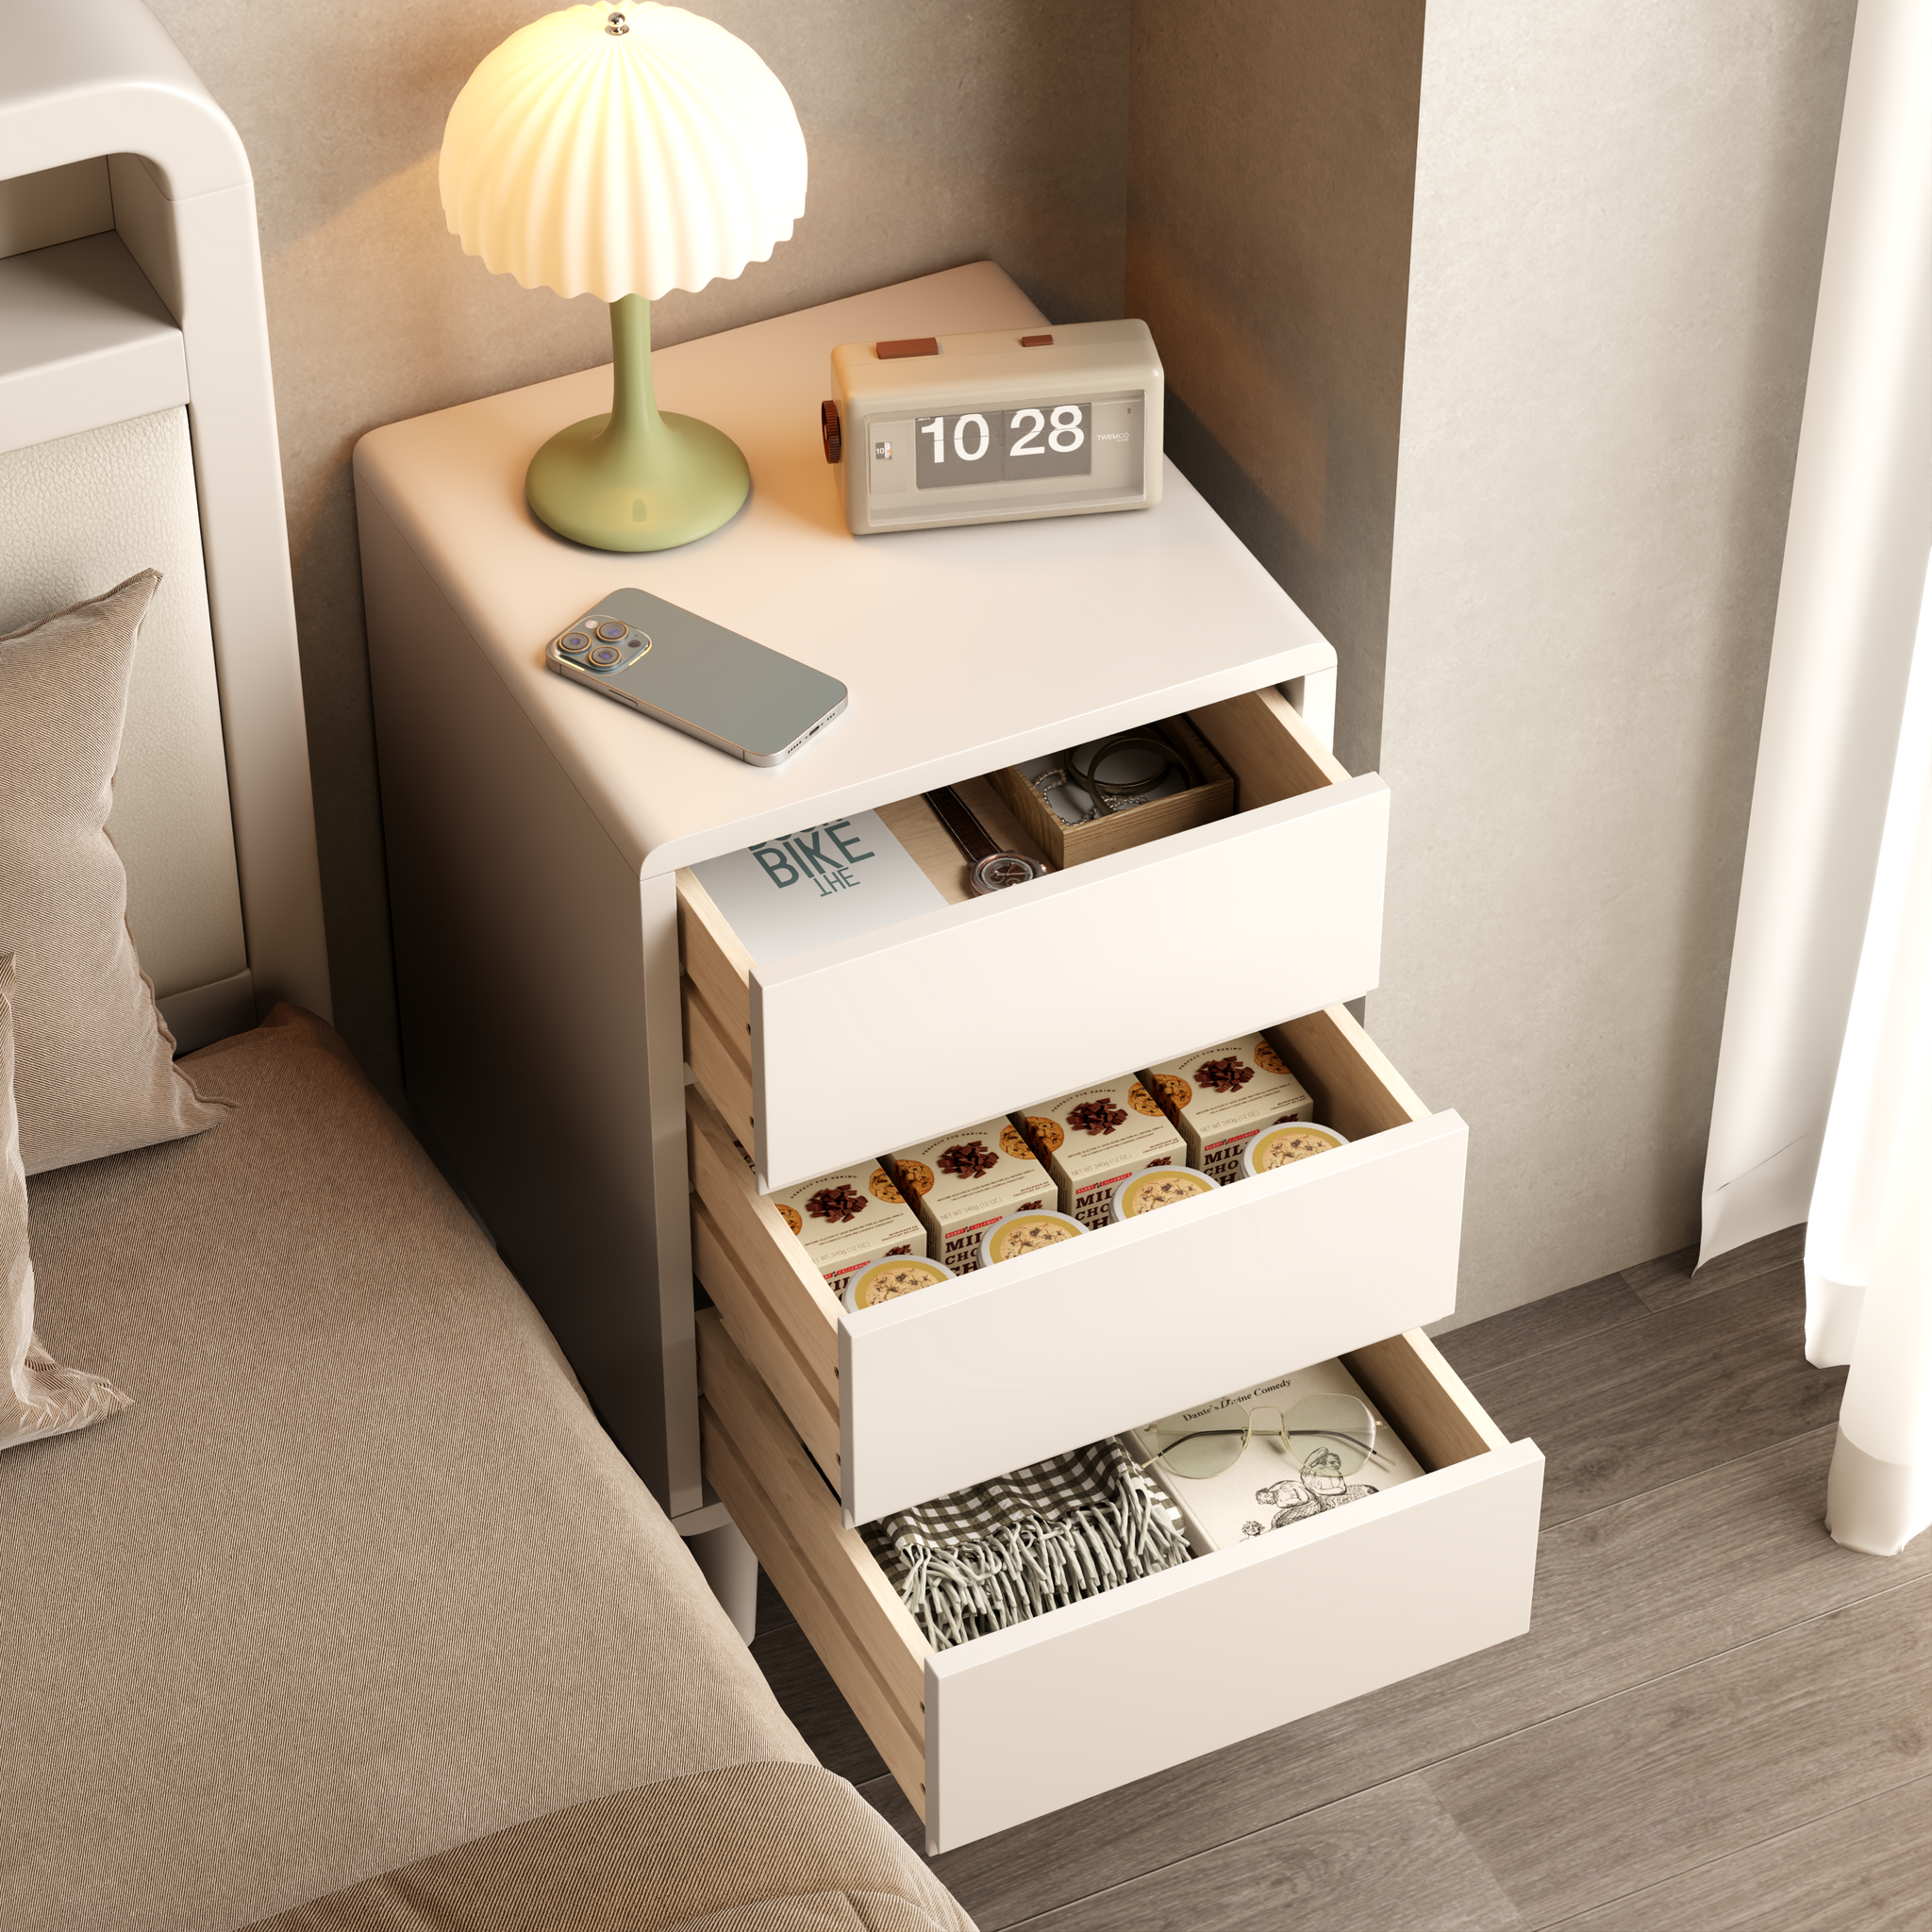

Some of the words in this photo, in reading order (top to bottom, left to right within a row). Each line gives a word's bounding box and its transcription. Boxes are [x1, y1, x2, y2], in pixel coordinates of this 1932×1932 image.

[922, 413, 990, 463] 10
[1009, 406, 1085, 457] 28
[1097, 432, 1129, 441] TWEMCO
[752, 821, 875, 889] BIKE
[1204, 1143, 1248, 1166] MIL
[1206, 1141, 1224, 1150] BARRY
[1075, 1188, 1113, 1208] MIL
[1077, 1185, 1095, 1193] BARRY
[945, 1231, 982, 1254] MIL
[946, 1229, 965, 1238] BARRY
[1182, 1405, 1220, 1422] Dante's
[1253, 1379, 1291, 1396] Comedy
